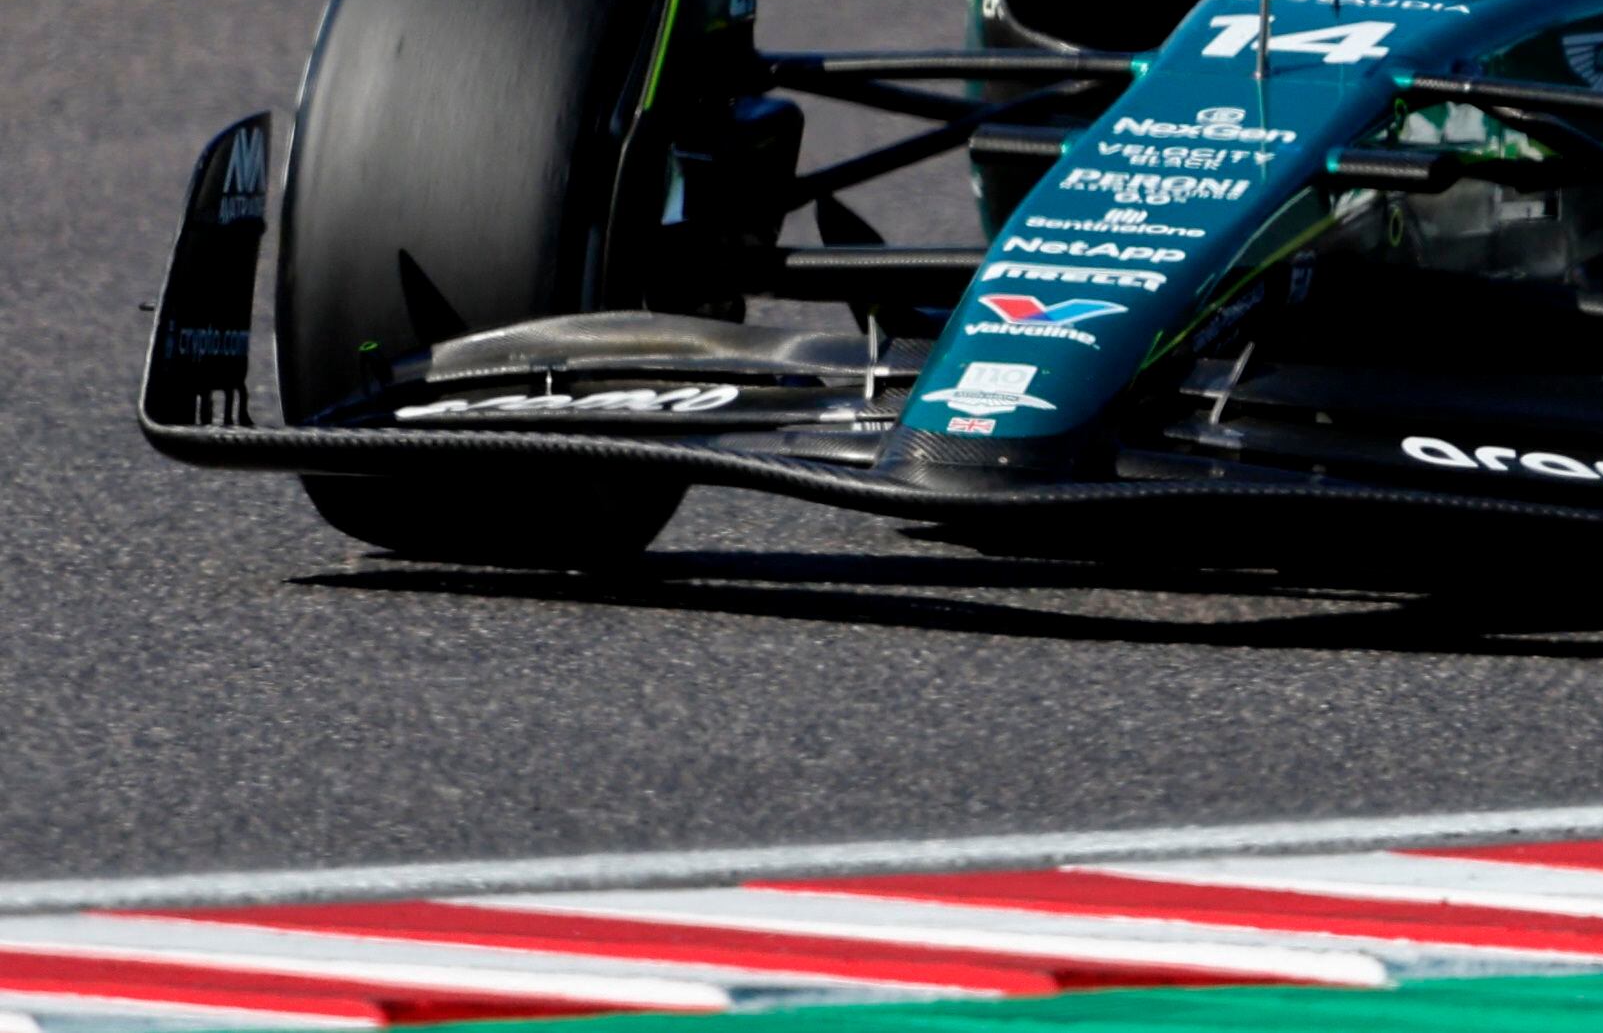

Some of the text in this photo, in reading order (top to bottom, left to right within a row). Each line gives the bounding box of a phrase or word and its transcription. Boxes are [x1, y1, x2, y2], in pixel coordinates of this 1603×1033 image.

[1201, 14, 1397, 64] 14
[1113, 117, 1298, 144] NexGen
[1098, 141, 1277, 165] VELOCITY
[1060, 167, 1251, 200] PERONI
[1025, 215, 1206, 238] SentinelOne
[1002, 235, 1187, 265] NetApp
[981, 261, 1168, 292] PIRELLI
[964, 321, 1097, 348] Valvoline
